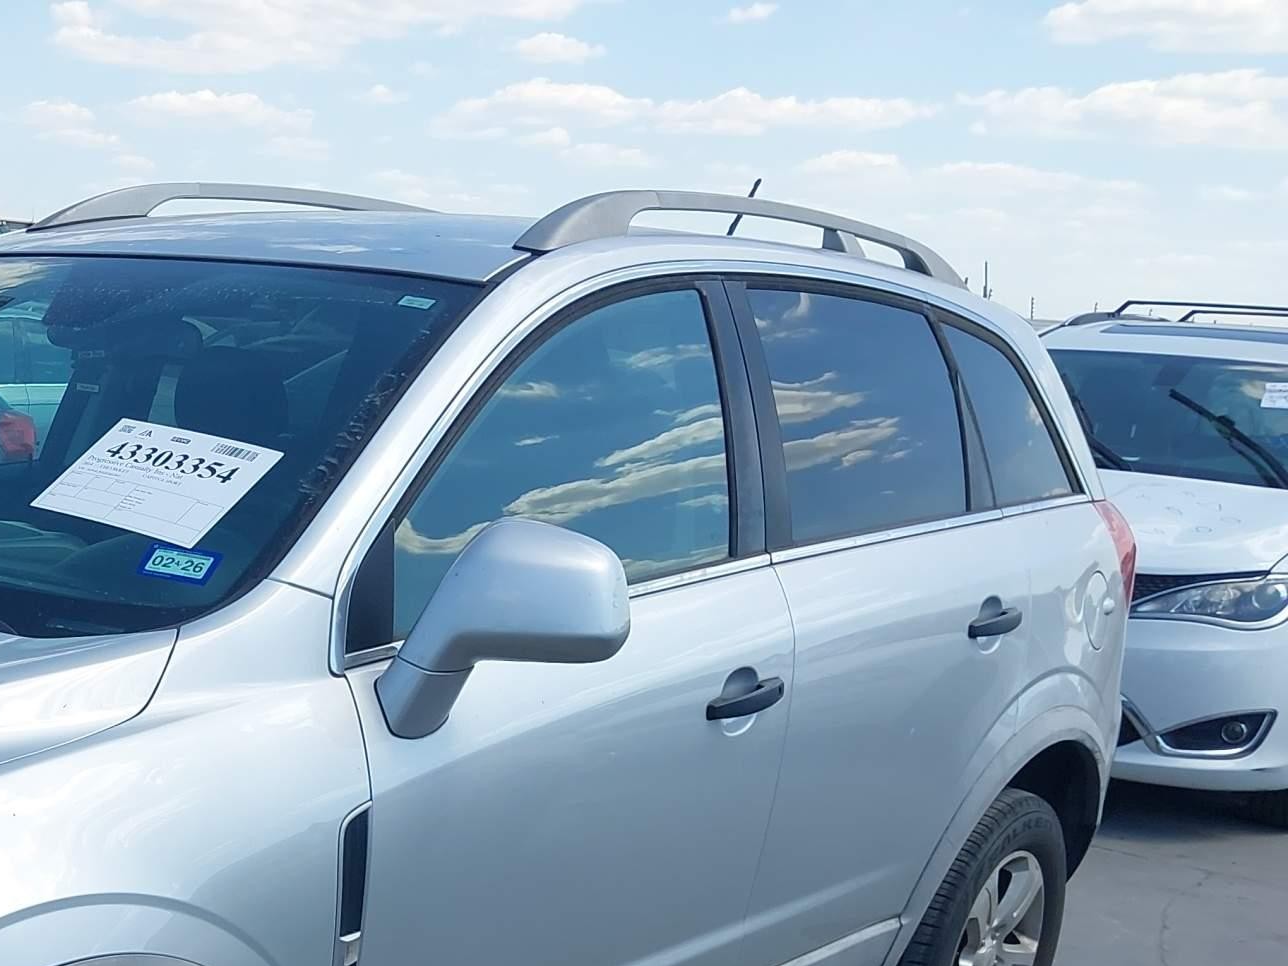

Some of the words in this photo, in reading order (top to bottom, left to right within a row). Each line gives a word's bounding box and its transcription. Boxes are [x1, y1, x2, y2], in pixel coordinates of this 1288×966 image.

[86, 454, 126, 468] Progressive
[125, 462, 152, 474] Casualty
[105, 441, 241, 484] 43303354
[151, 555, 176, 569] 02
[180, 559, 205, 573] 26
